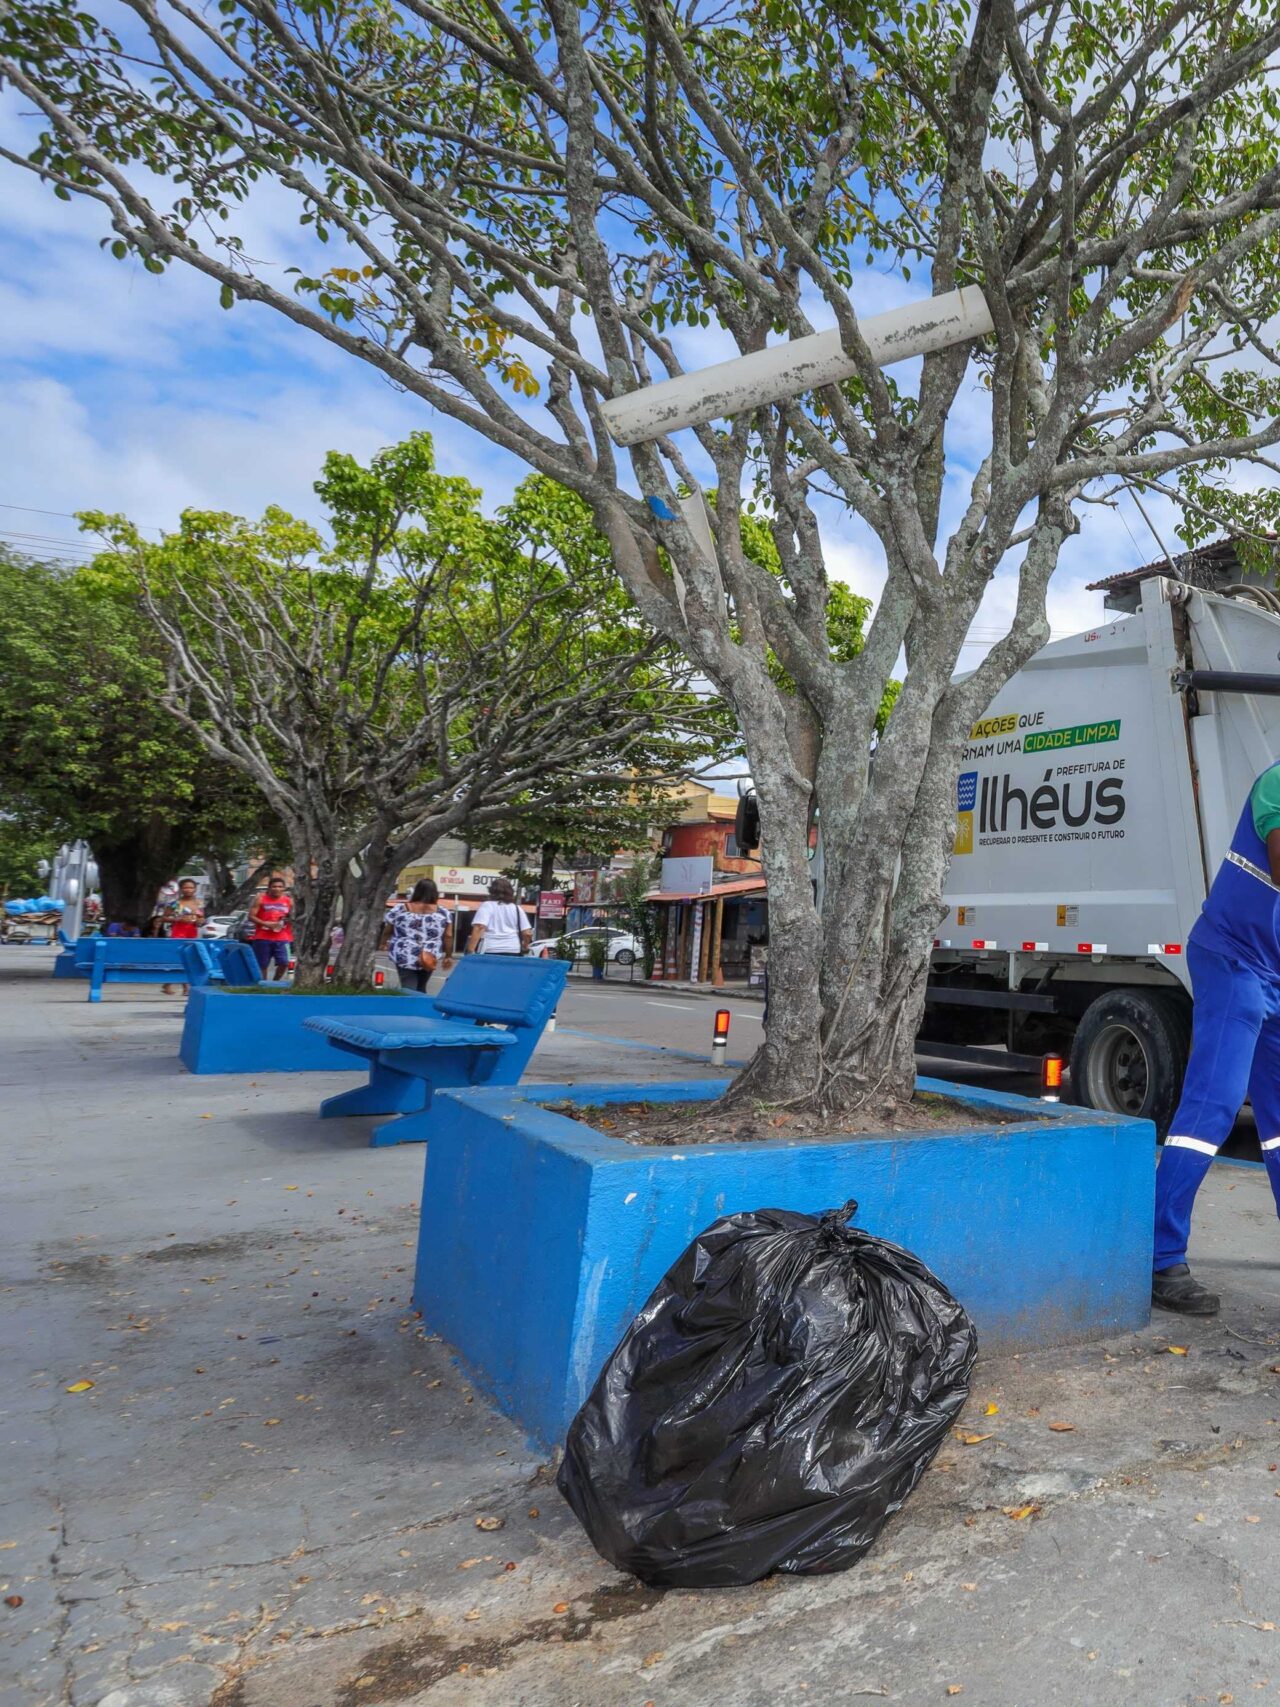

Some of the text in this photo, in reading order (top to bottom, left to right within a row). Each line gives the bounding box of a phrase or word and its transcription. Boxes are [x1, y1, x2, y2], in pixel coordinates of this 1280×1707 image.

[975, 711, 1045, 738] AÇÕES QUE
[996, 739, 1021, 755] UMA
[1024, 730, 1072, 750] CIDADE
[1074, 724, 1118, 743] LIMPA
[1056, 759, 1126, 777] PREFEITURA DE
[979, 768, 1126, 833] Ilhéus
[979, 829, 1125, 846] RECUPERAR O PRESENTE E CONSTRUIR O FUTURO
